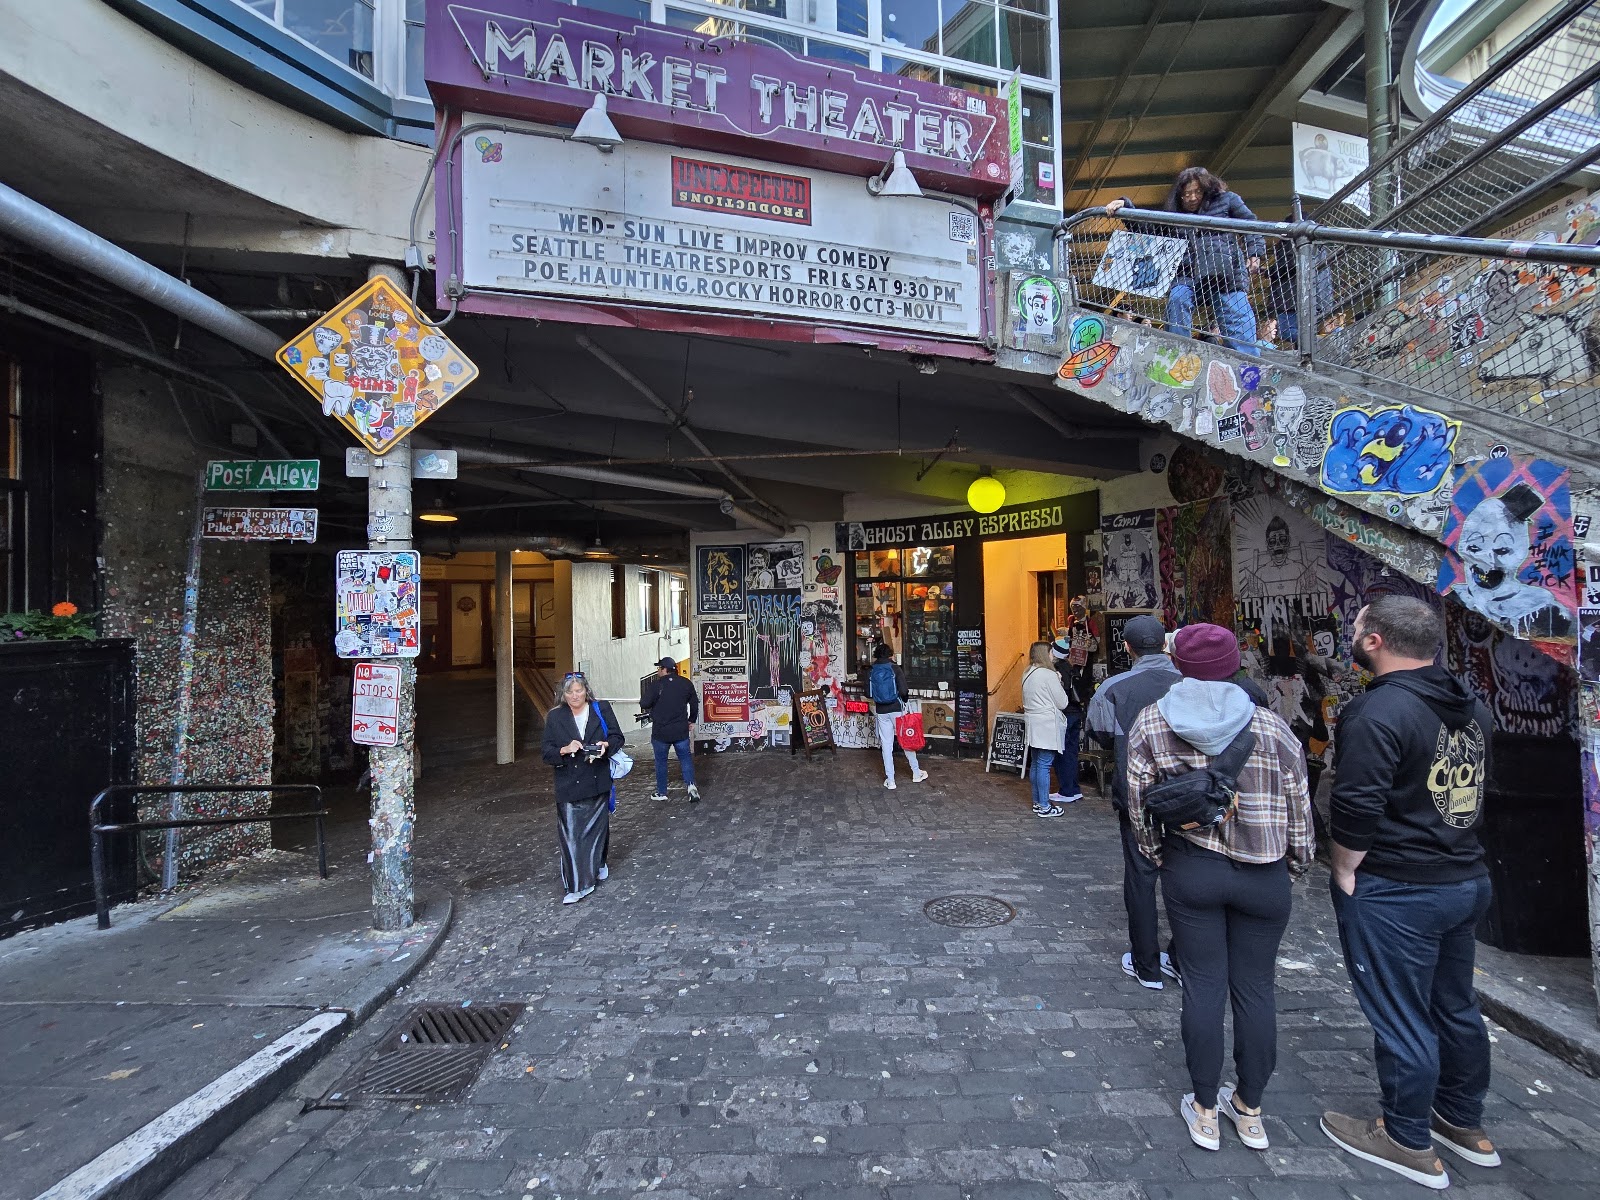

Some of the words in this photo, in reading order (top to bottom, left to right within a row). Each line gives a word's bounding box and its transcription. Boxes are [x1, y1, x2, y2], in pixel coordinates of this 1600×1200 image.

[484, 19, 727, 113] MARKET
[750, 74, 977, 162] THEATER
[678, 161, 805, 205] UNEXPECTED
[679, 191, 804, 218] PRODUCTIONS
[1500, 204, 1559, 237] HILLCLIMB
[624, 221, 665, 243] SUN
[679, 228, 724, 251] LIVE
[736, 235, 808, 261] IMPROV
[816, 247, 890, 272] COMEDY
[512, 234, 605, 261] SEATTLE
[623, 245, 791, 281] THEATRESPORTS
[807, 268, 889, 295] FRI&SAT
[893, 279, 929, 299] 9:30
[934, 285, 956, 303] PM
[211, 463, 253, 487] Post
[259, 462, 313, 489] Alley
[207, 522, 233, 533] Pike
[865, 524, 916, 545] GHOST
[921, 518, 974, 541] ALLEY
[979, 506, 1063, 536] ESPRESSO
[1538, 524, 1553, 541] I
[1531, 544, 1569, 562] THINK
[1526, 573, 1572, 590] SICK
[702, 593, 742, 601] FREYA
[705, 624, 741, 639] ALIBI
[358, 667, 370, 678] NO
[360, 683, 393, 699] STOPS
[1450, 789, 1477, 811] Banquet
